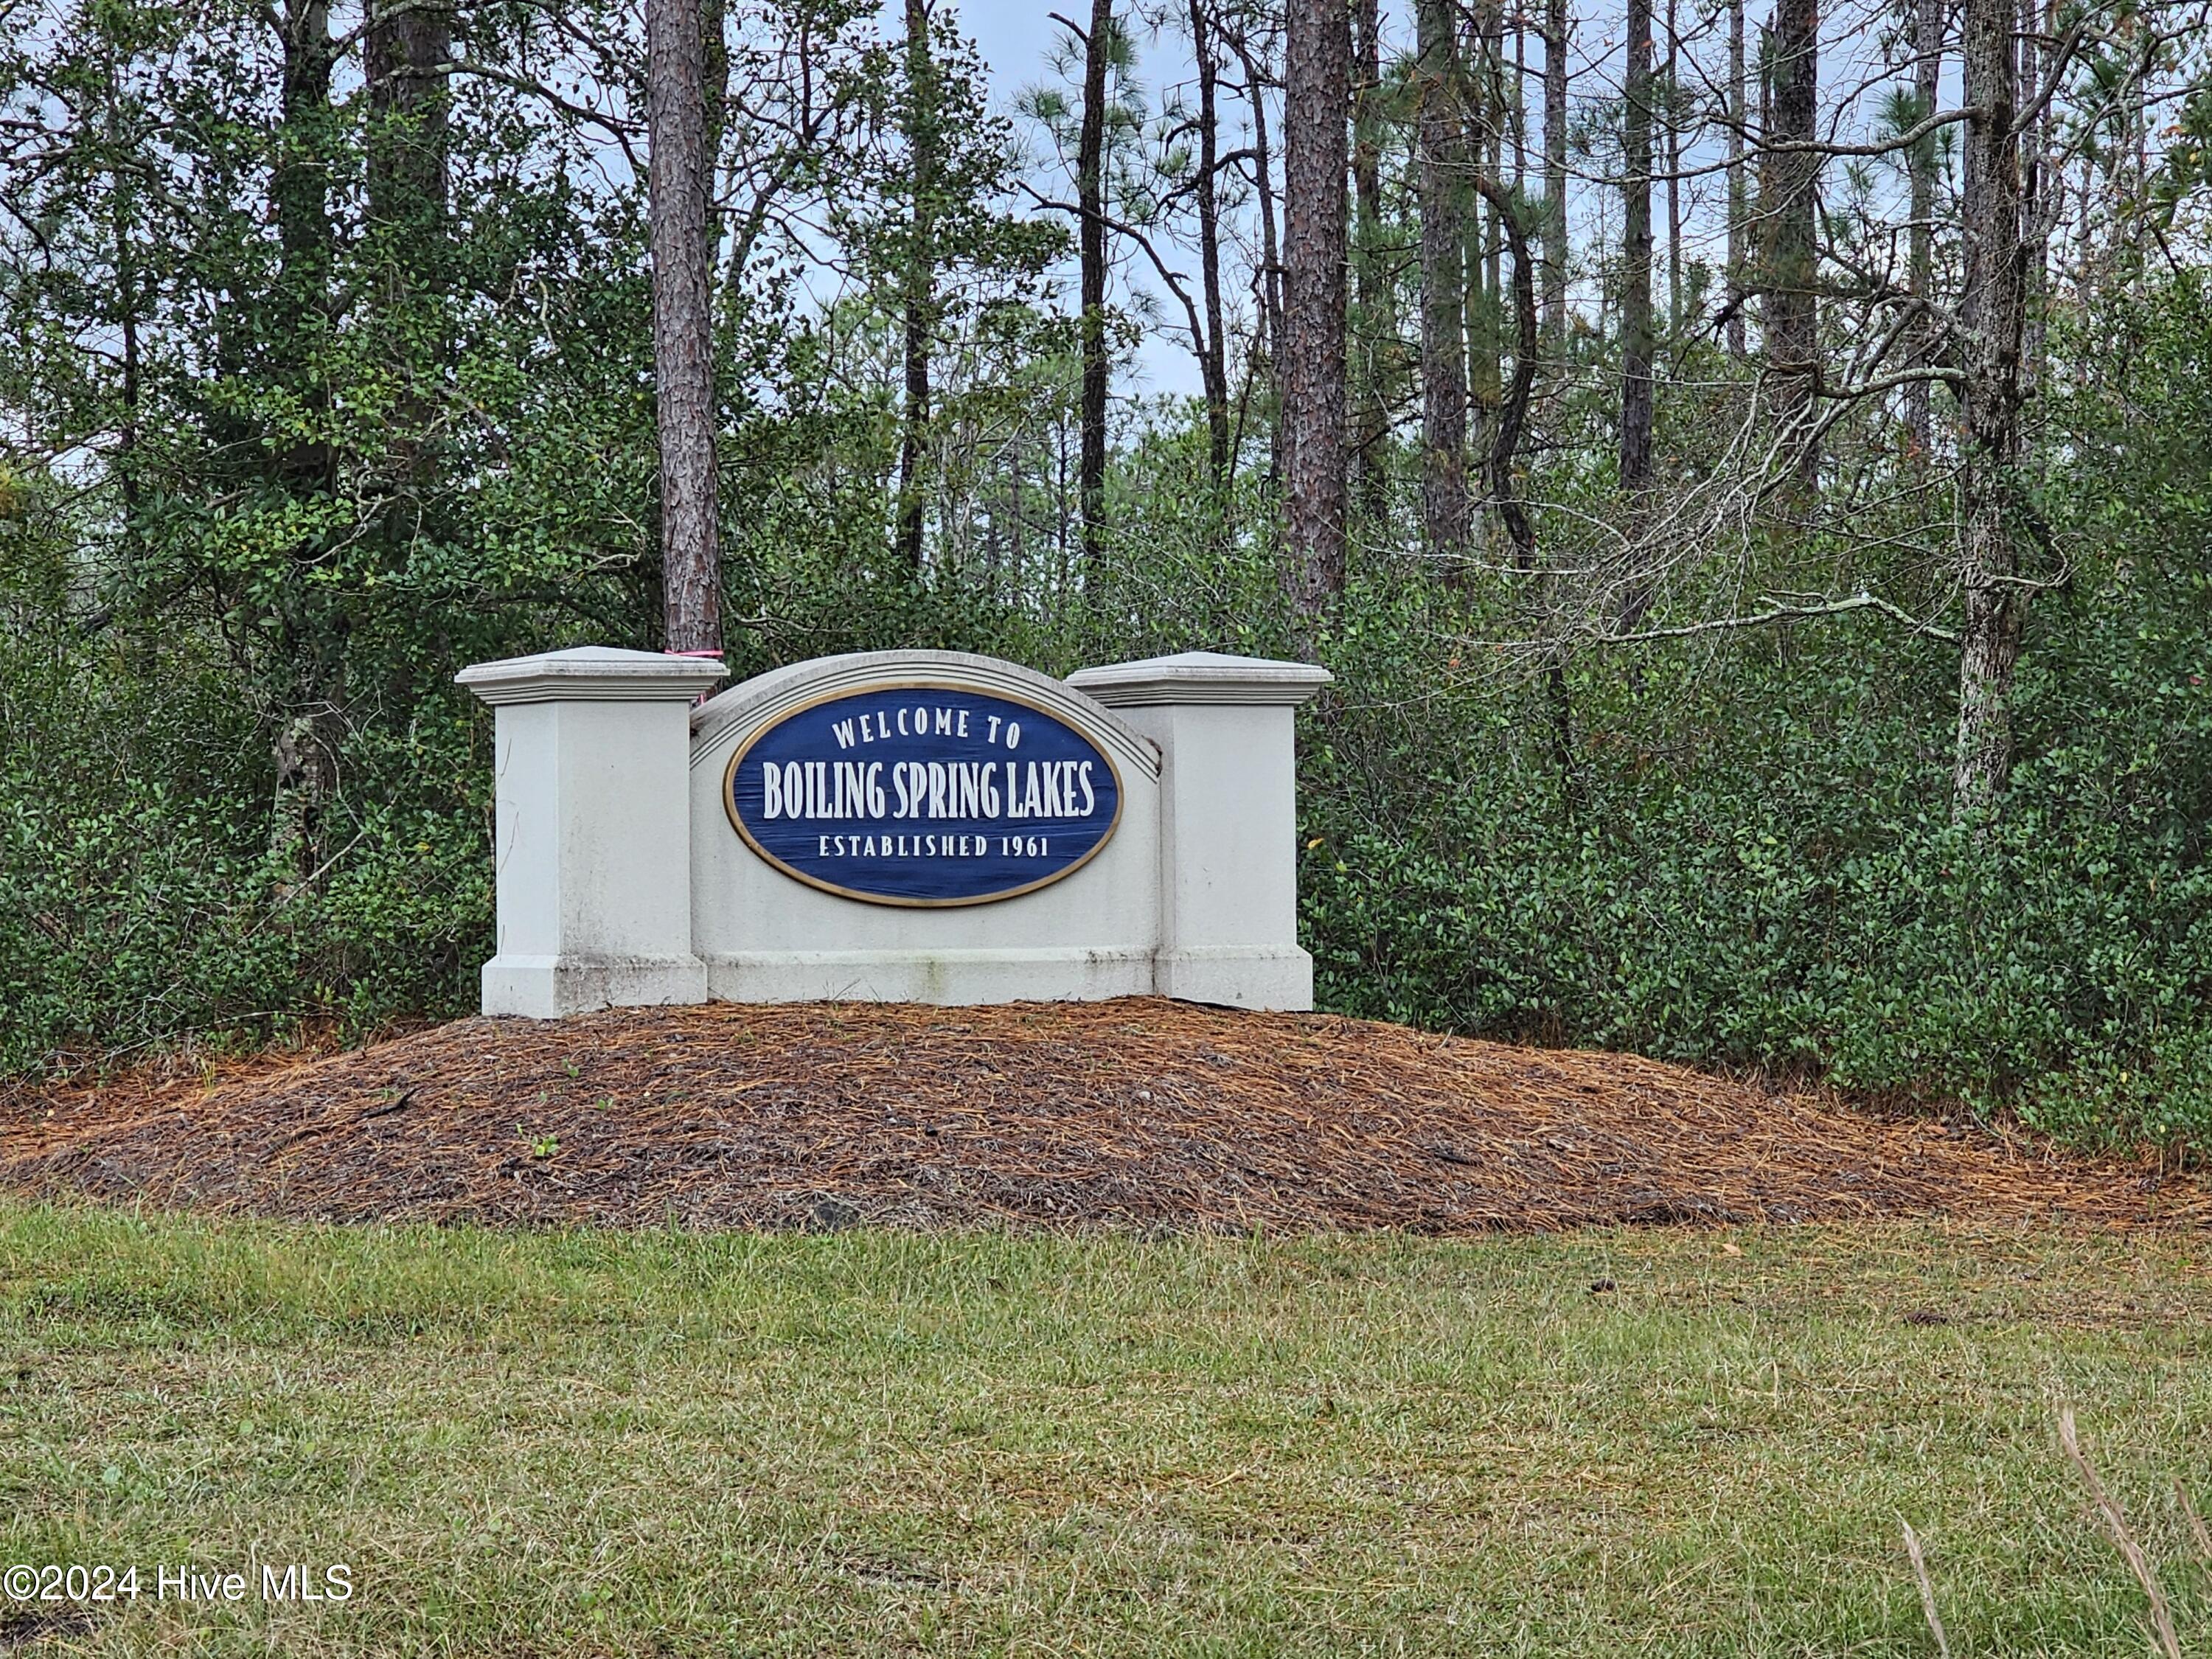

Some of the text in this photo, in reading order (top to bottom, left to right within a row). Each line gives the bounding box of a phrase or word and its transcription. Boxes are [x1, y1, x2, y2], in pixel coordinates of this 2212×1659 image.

[832, 706, 1020, 749] WELCOME TO
[762, 760, 1096, 819] BOILING SPRING LAKES
[818, 835, 1048, 857] ESTABLISHED 1961
